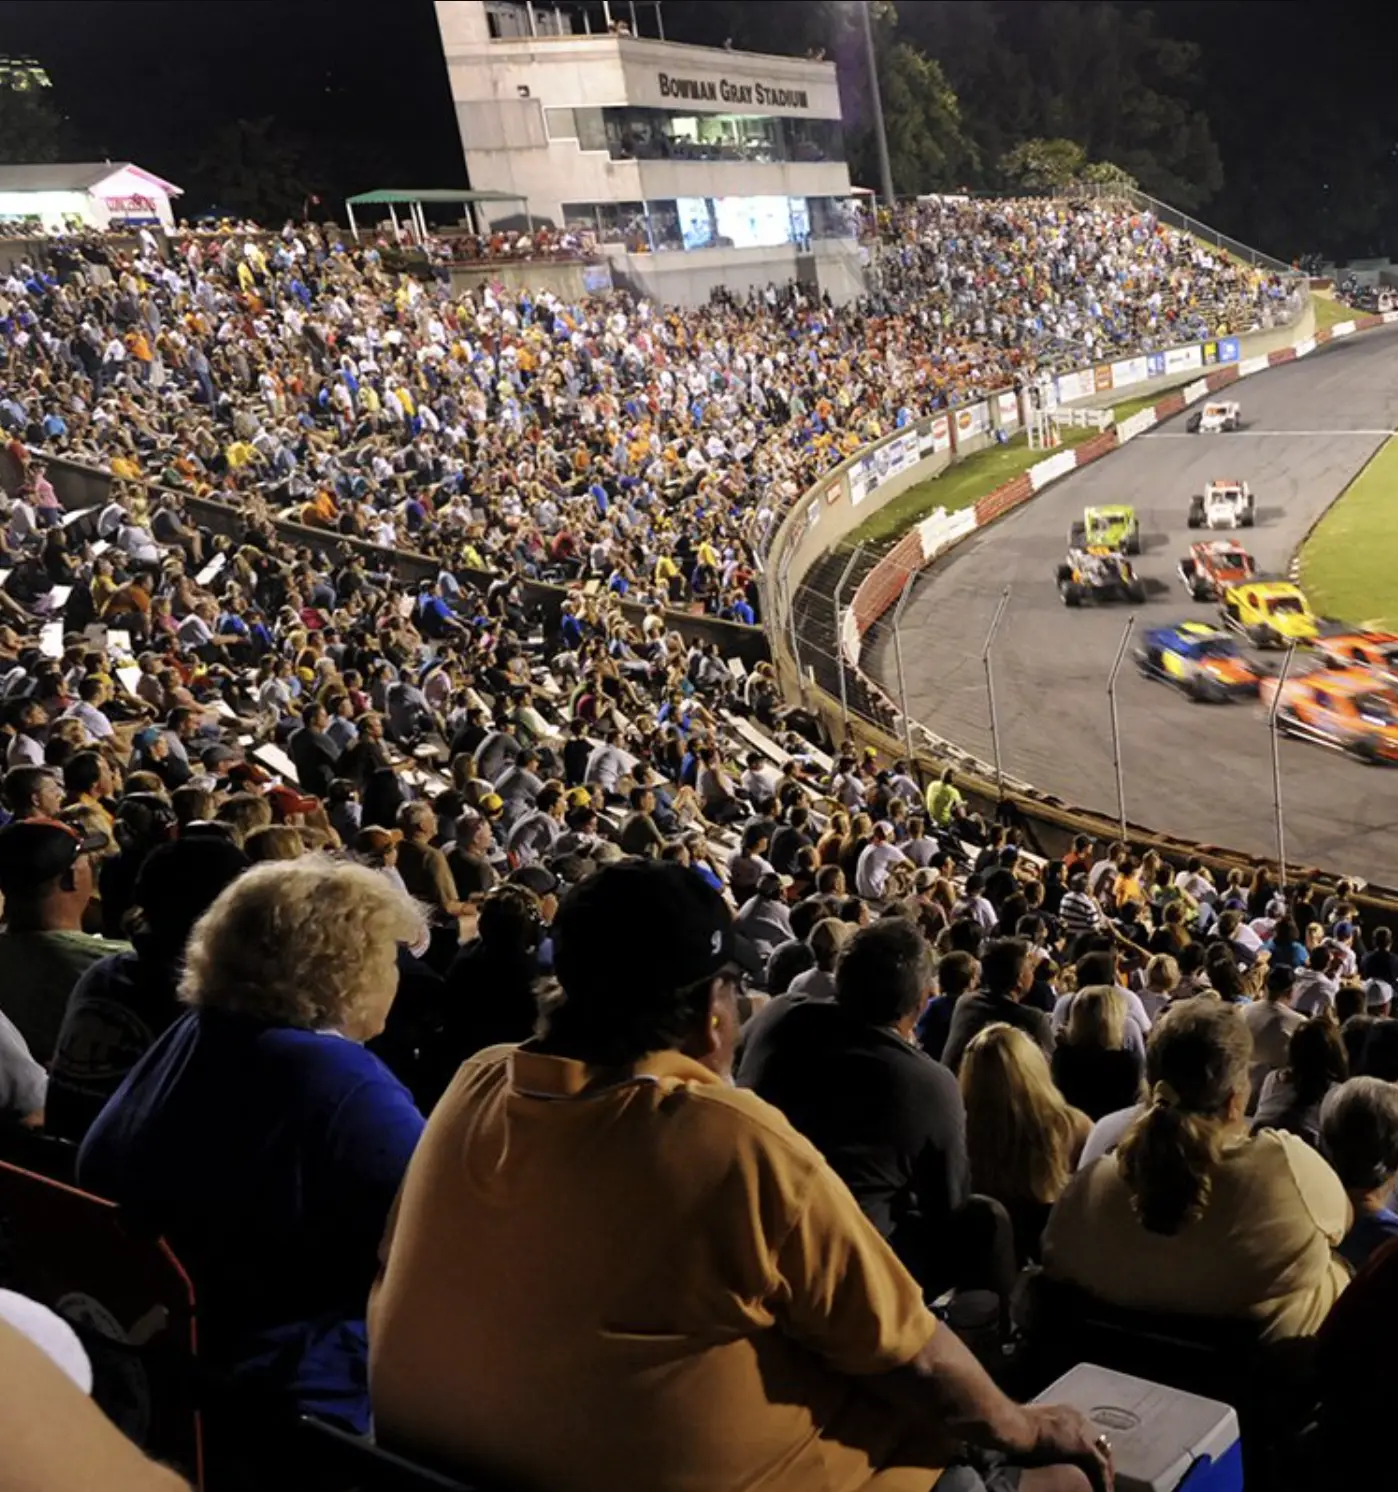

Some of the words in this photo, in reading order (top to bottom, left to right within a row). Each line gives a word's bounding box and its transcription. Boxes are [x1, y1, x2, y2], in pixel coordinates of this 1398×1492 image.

[658, 72, 717, 101] BOWMAN
[720, 79, 752, 104] GRAY
[755, 83, 809, 108] STADIUM
